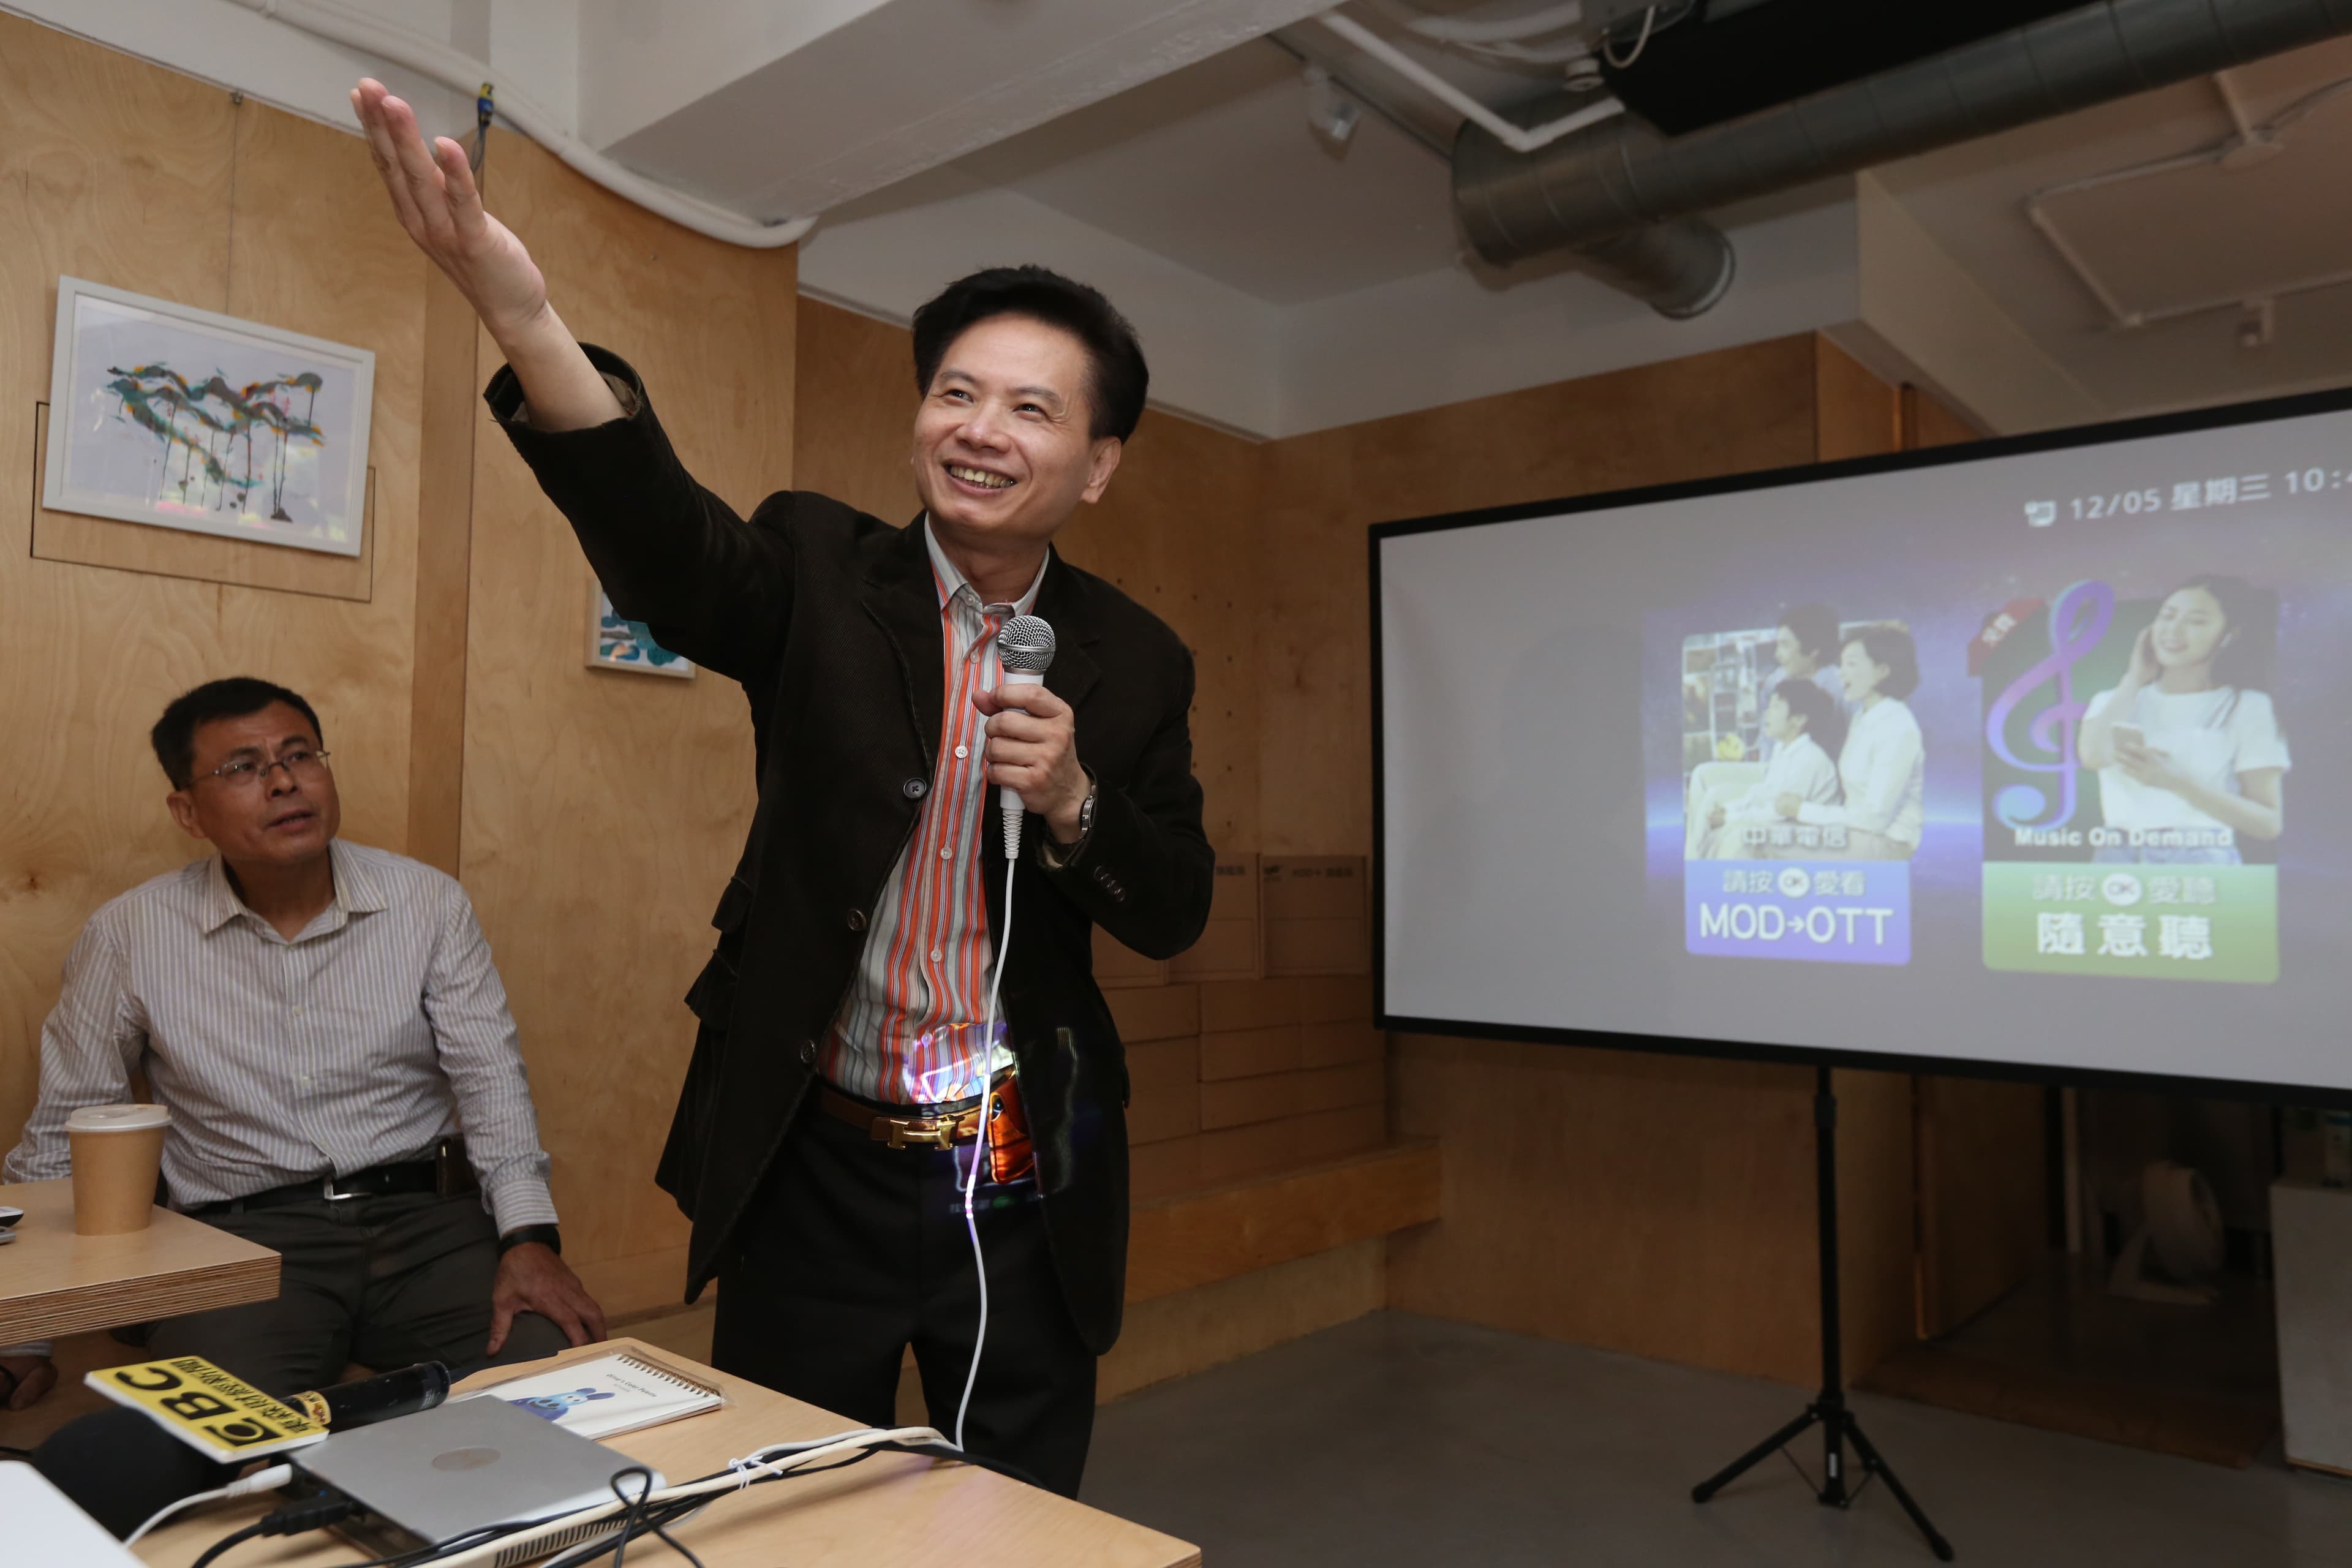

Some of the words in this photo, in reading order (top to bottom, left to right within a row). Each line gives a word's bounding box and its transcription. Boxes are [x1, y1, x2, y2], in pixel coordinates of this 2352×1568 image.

[2070, 489, 2162, 521] 12/05
[2171, 473, 2271, 511] 星期三
[2015, 828, 2081, 847] Music
[2089, 828, 2122, 846] On
[2129, 828, 2233, 847] Demand
[1723, 870, 1774, 894] 請按
[2037, 913, 2213, 959] 隨意聽
